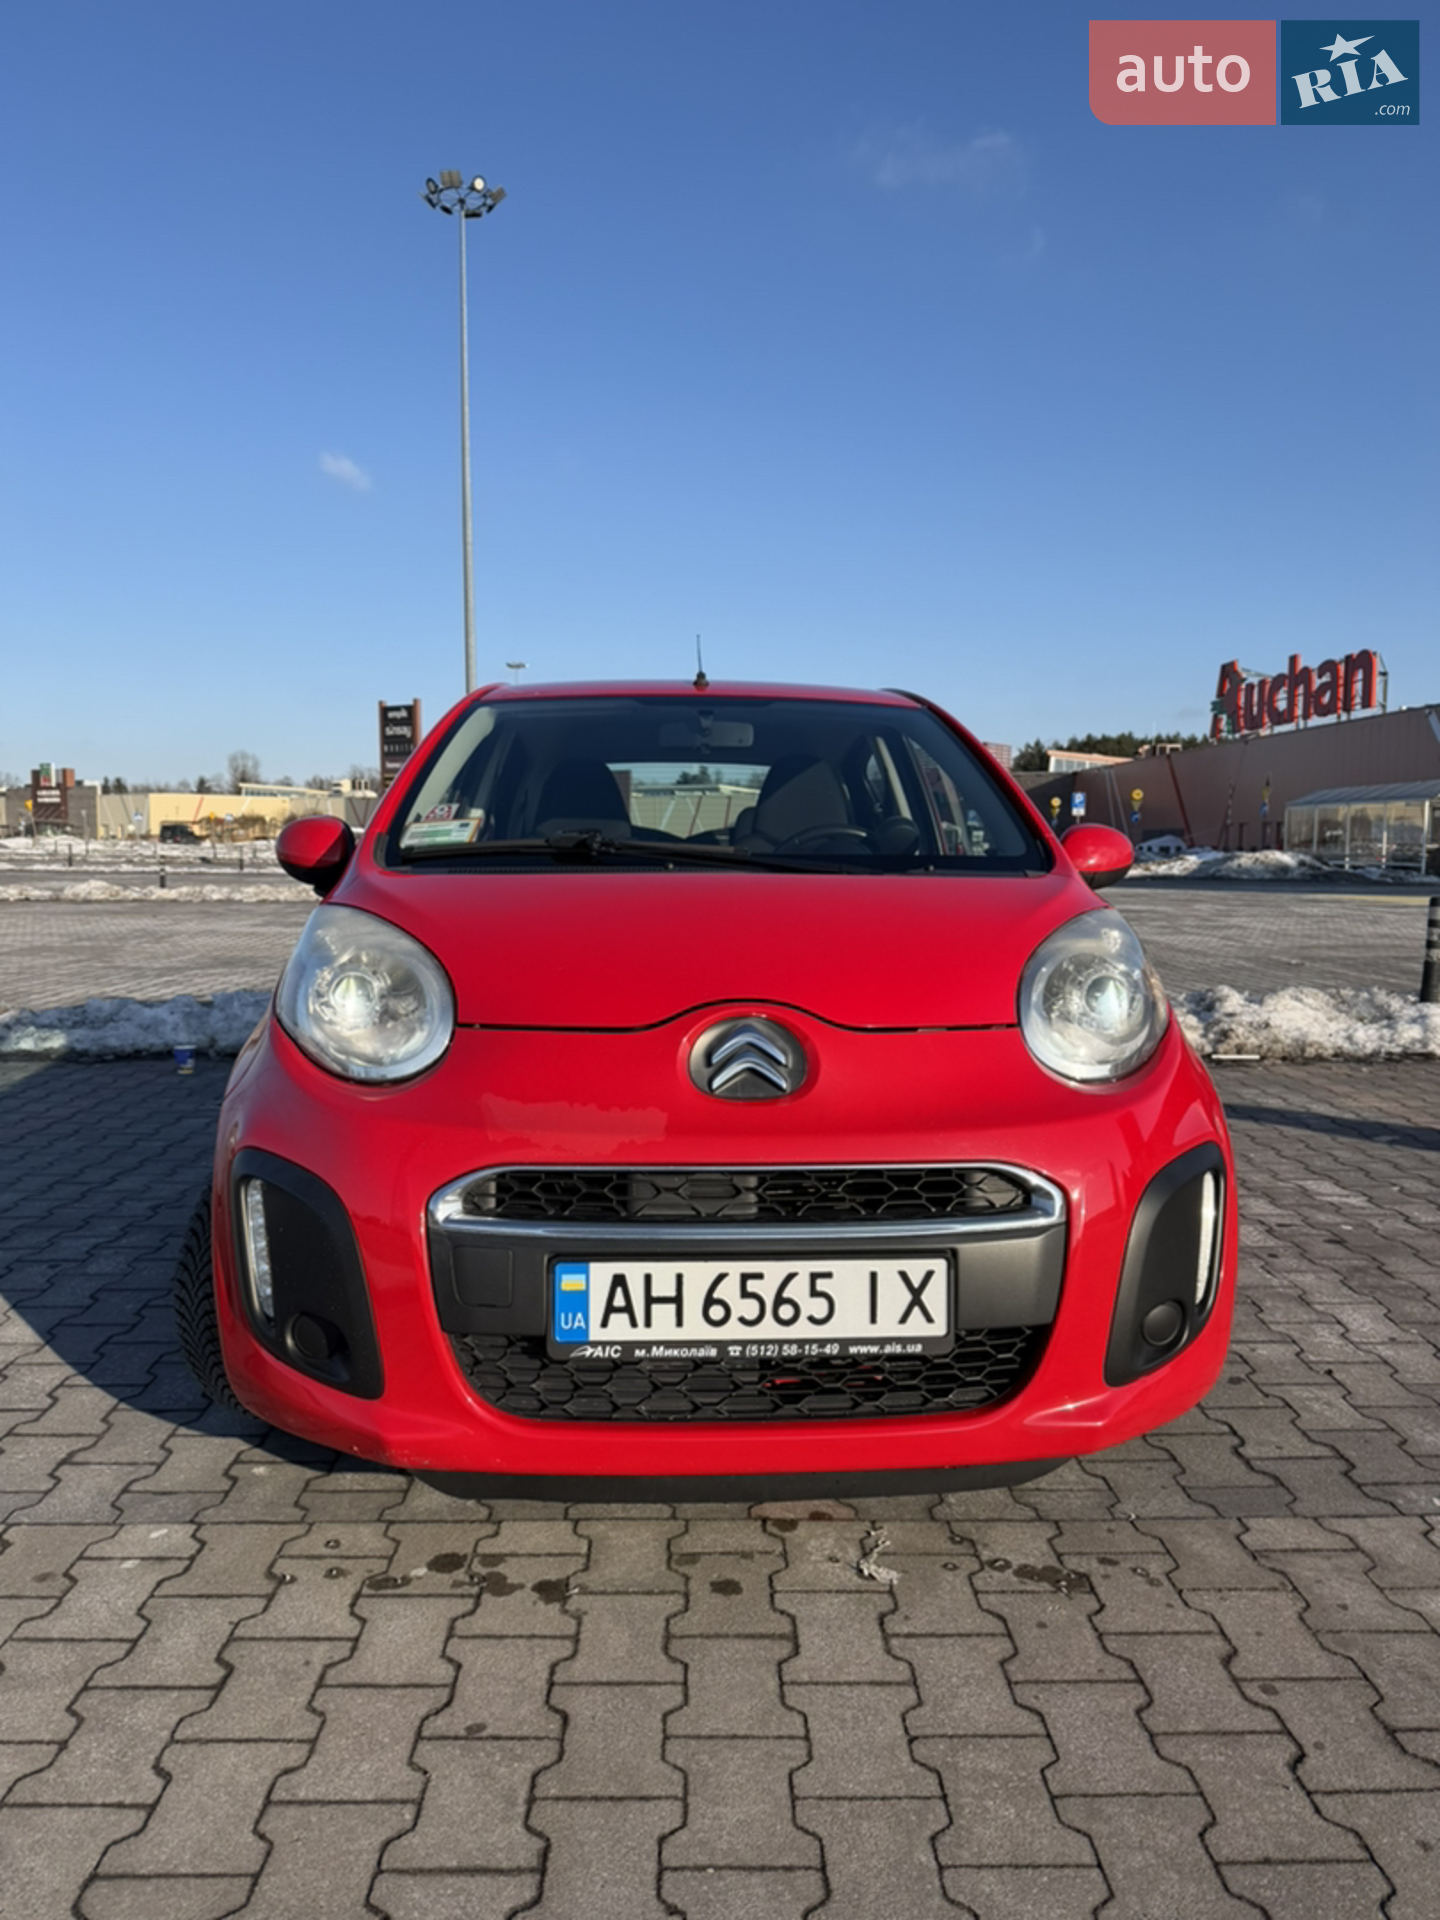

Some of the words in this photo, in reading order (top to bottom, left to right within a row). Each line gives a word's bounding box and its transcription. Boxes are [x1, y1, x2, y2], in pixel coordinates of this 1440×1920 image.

[1209, 648, 1377, 740] Auchan
[600, 1272, 684, 1329] AH
[702, 1271, 835, 1328] 6565
[561, 1312, 586, 1330] UA
[746, 1343, 779, 1357] (512)
[782, 1342, 840, 1356] 58-15-49
[849, 1341, 923, 1354] www.ais.ua
